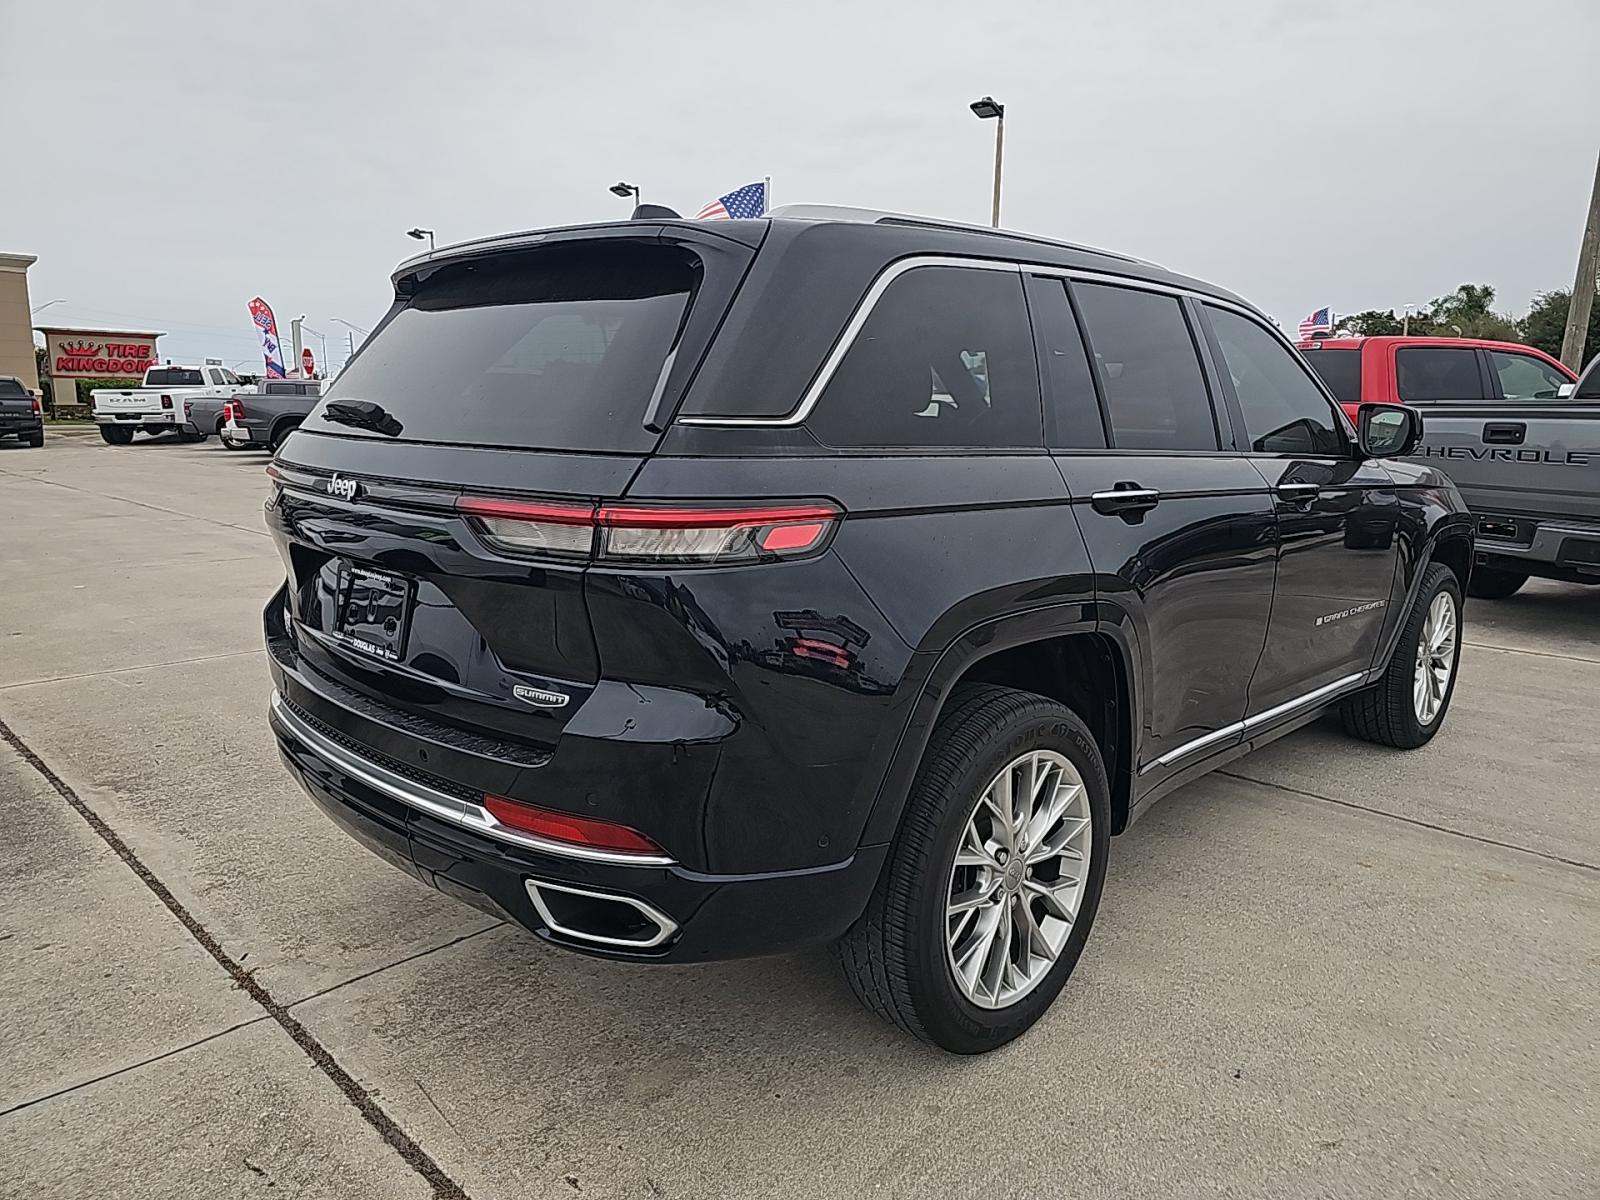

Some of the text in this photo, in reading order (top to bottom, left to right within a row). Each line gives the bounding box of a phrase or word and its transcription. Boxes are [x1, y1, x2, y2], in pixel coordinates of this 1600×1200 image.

[105, 343, 151, 359] TIRE
[327, 473, 356, 501] Jeep
[1323, 599, 1386, 624] GRAND CHEROKEE
[353, 638, 375, 653] DOUGLAS
[516, 688, 565, 703] SUMMIT
